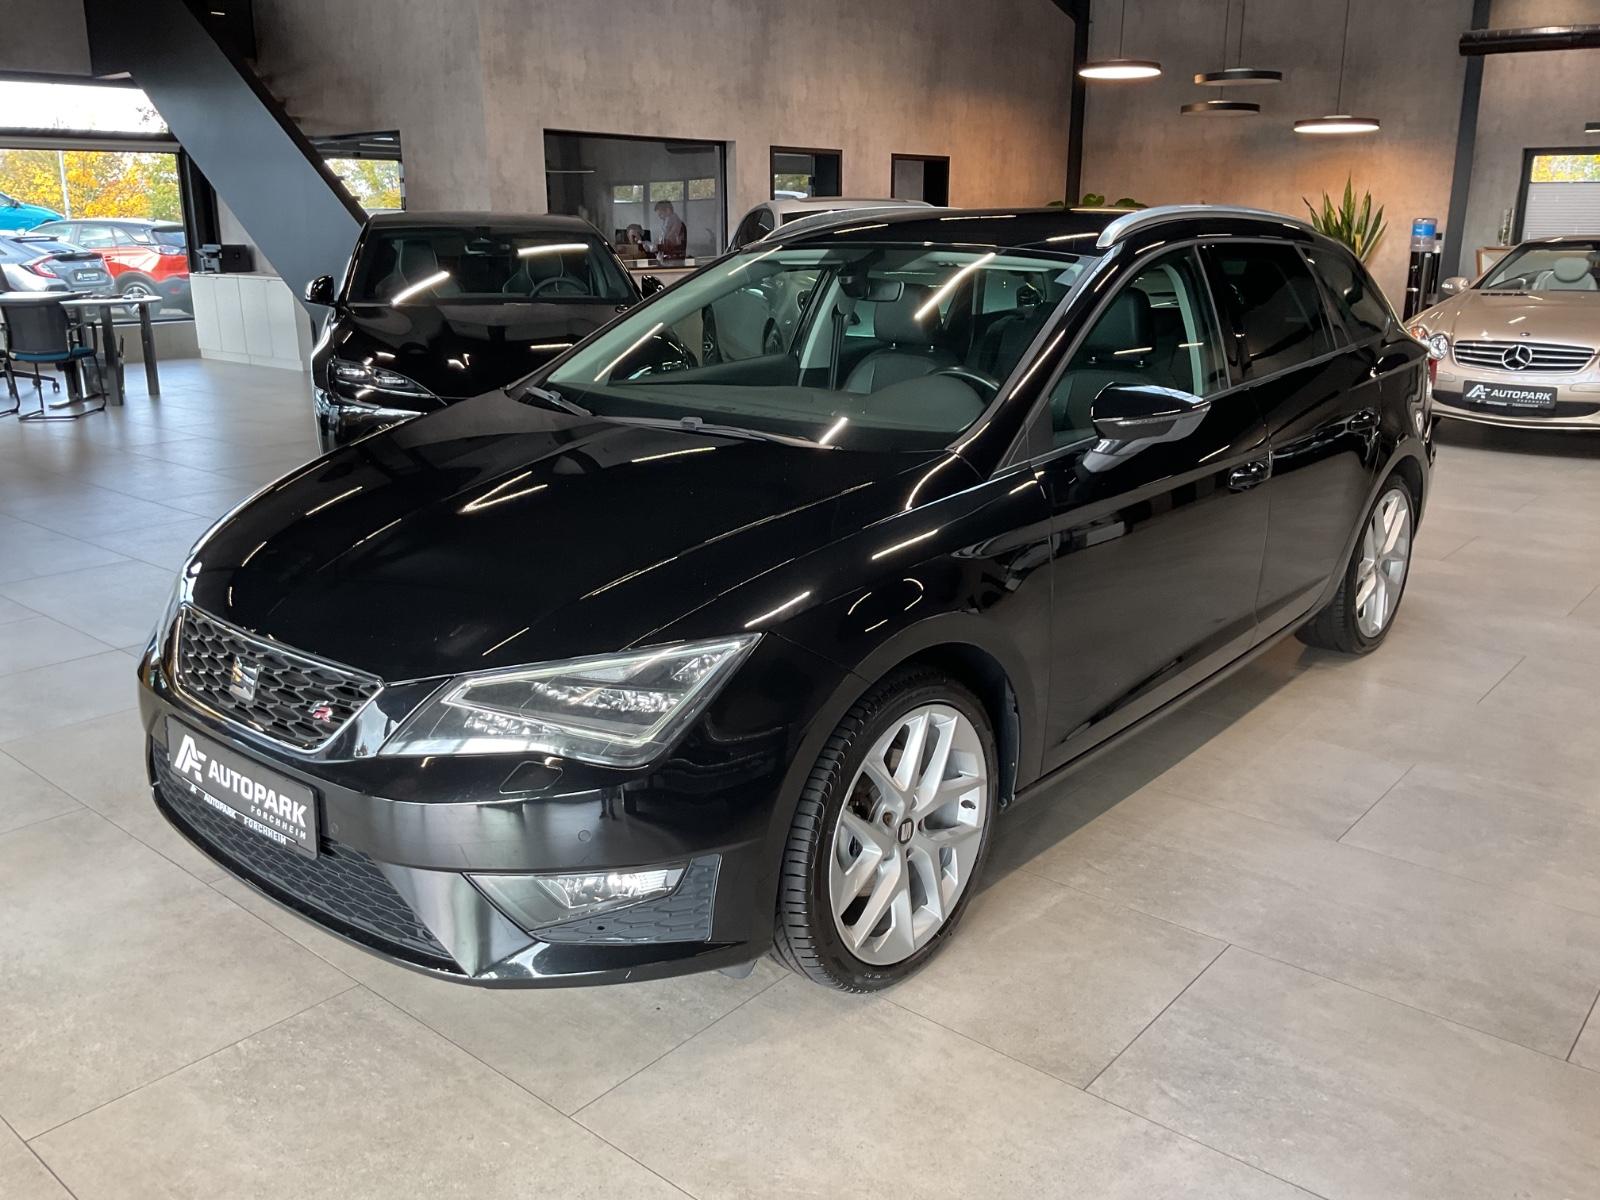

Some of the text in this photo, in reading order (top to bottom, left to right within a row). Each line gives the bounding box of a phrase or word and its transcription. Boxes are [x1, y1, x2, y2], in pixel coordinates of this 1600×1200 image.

[1491, 389, 1552, 401] AUTOPARK
[208, 759, 307, 828] AUTOPARK
[203, 792, 287, 845] AUTOPARK FORCHHEIM
[250, 805, 306, 840] FORCHHEIM
